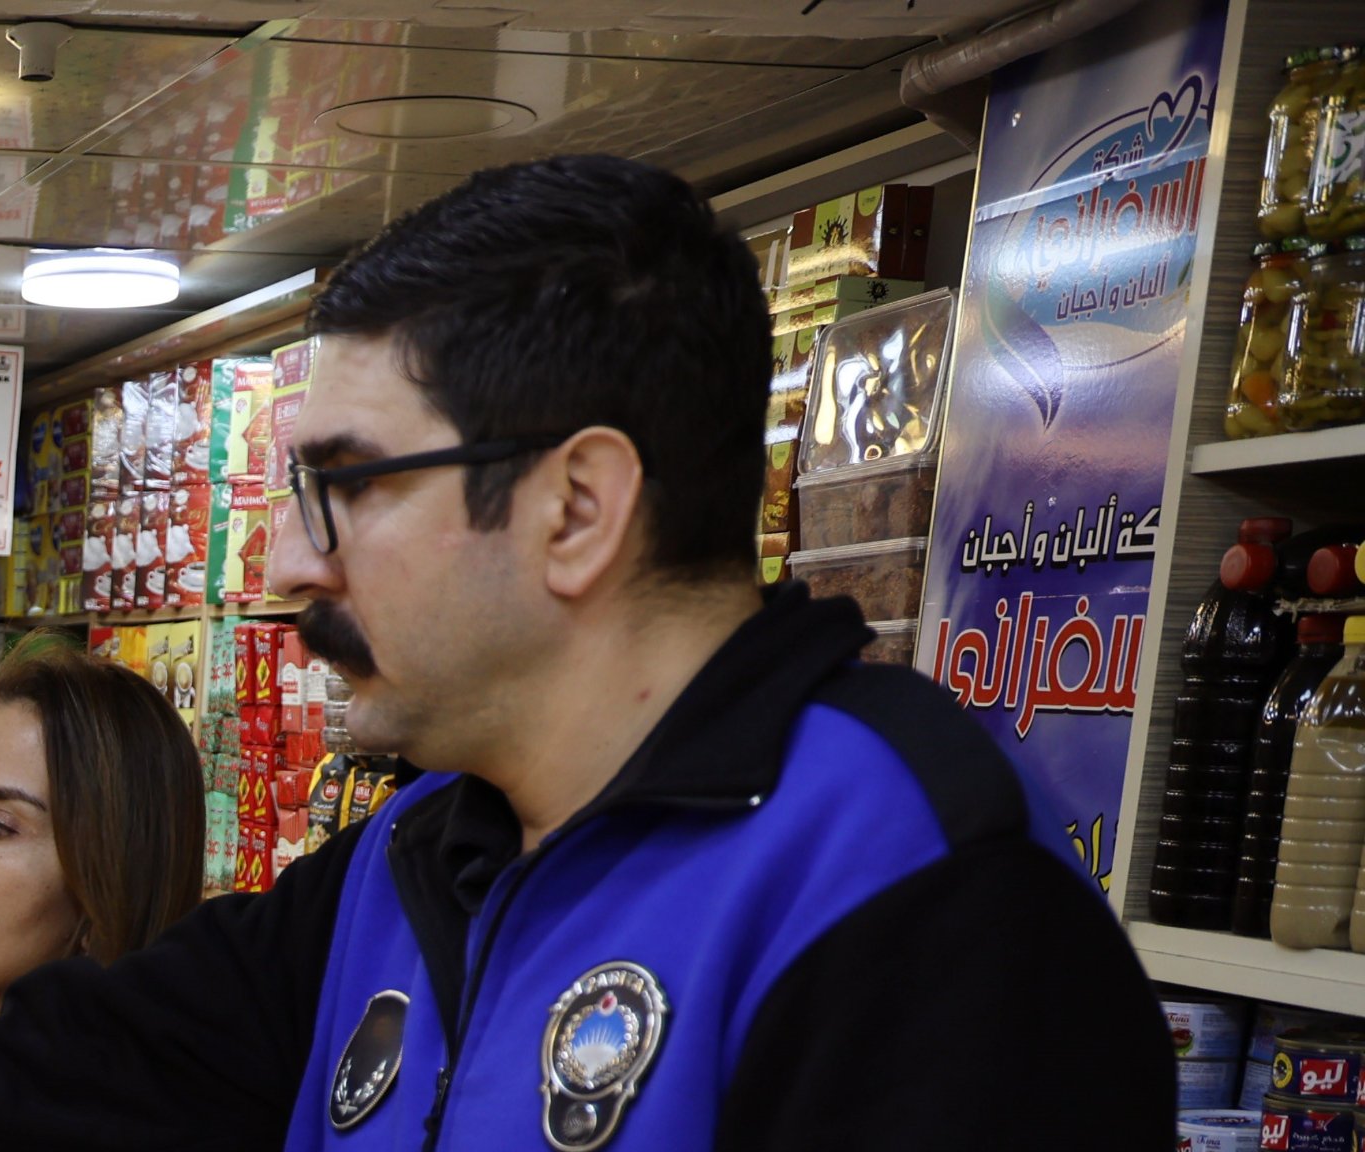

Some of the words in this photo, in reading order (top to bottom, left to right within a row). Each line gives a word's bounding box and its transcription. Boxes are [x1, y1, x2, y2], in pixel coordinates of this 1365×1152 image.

[961, 502, 1034, 575] أجبان
[1032, 530, 1048, 568] و
[1052, 494, 1118, 568] ألبان
[1301, 1060, 1345, 1091] ليو
[1261, 1115, 1287, 1146] ليو
